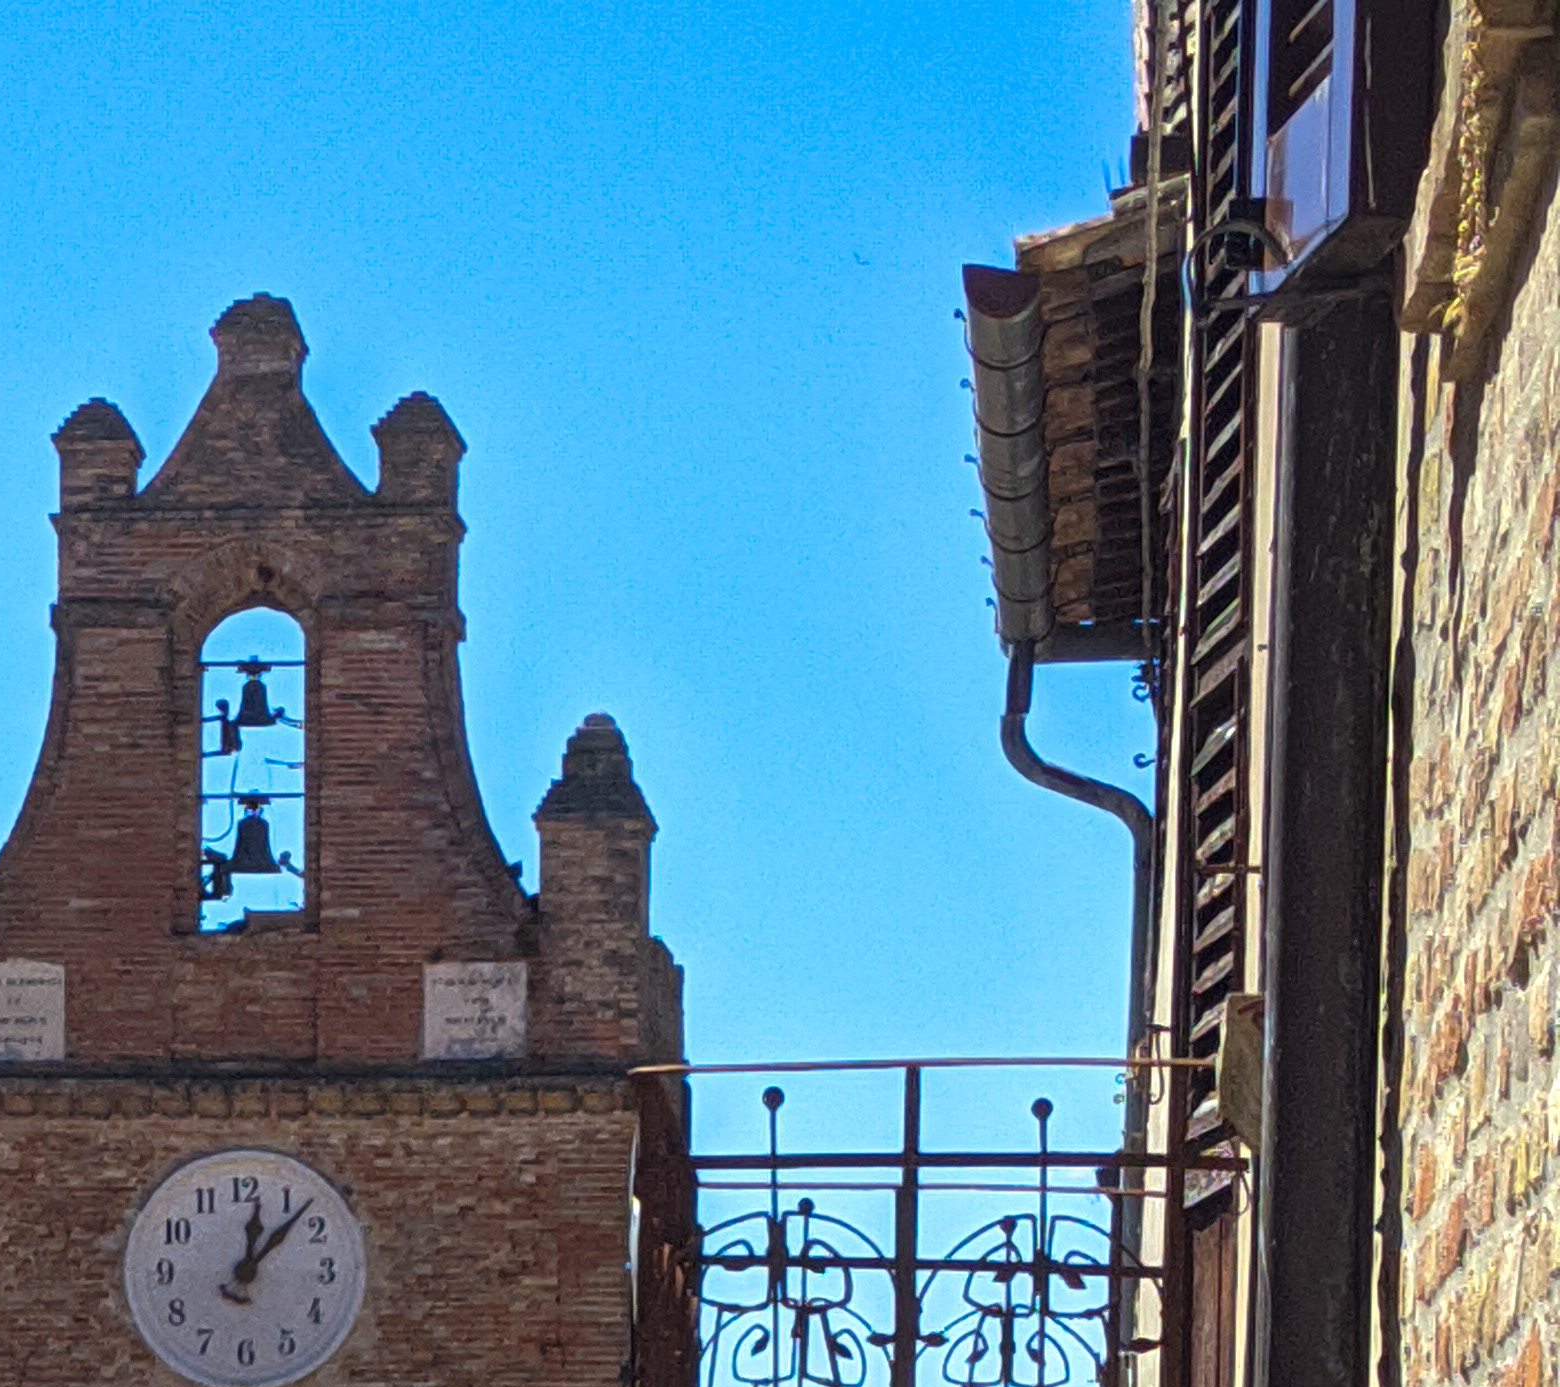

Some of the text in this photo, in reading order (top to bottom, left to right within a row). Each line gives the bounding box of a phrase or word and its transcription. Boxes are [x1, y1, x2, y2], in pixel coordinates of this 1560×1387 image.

[195, 1188, 215, 1214] 11
[231, 1177, 260, 1203] 12
[281, 1186, 291, 1213] 1
[163, 1217, 191, 1245] 10
[308, 1217, 326, 1244] 2
[156, 1258, 175, 1284] 9
[319, 1258, 335, 1285] 3
[168, 1298, 185, 1326] 8
[306, 1297, 321, 1324] 4
[197, 1328, 214, 1355] 7
[237, 1339, 255, 1366] 6
[278, 1328, 296, 1355] 5
